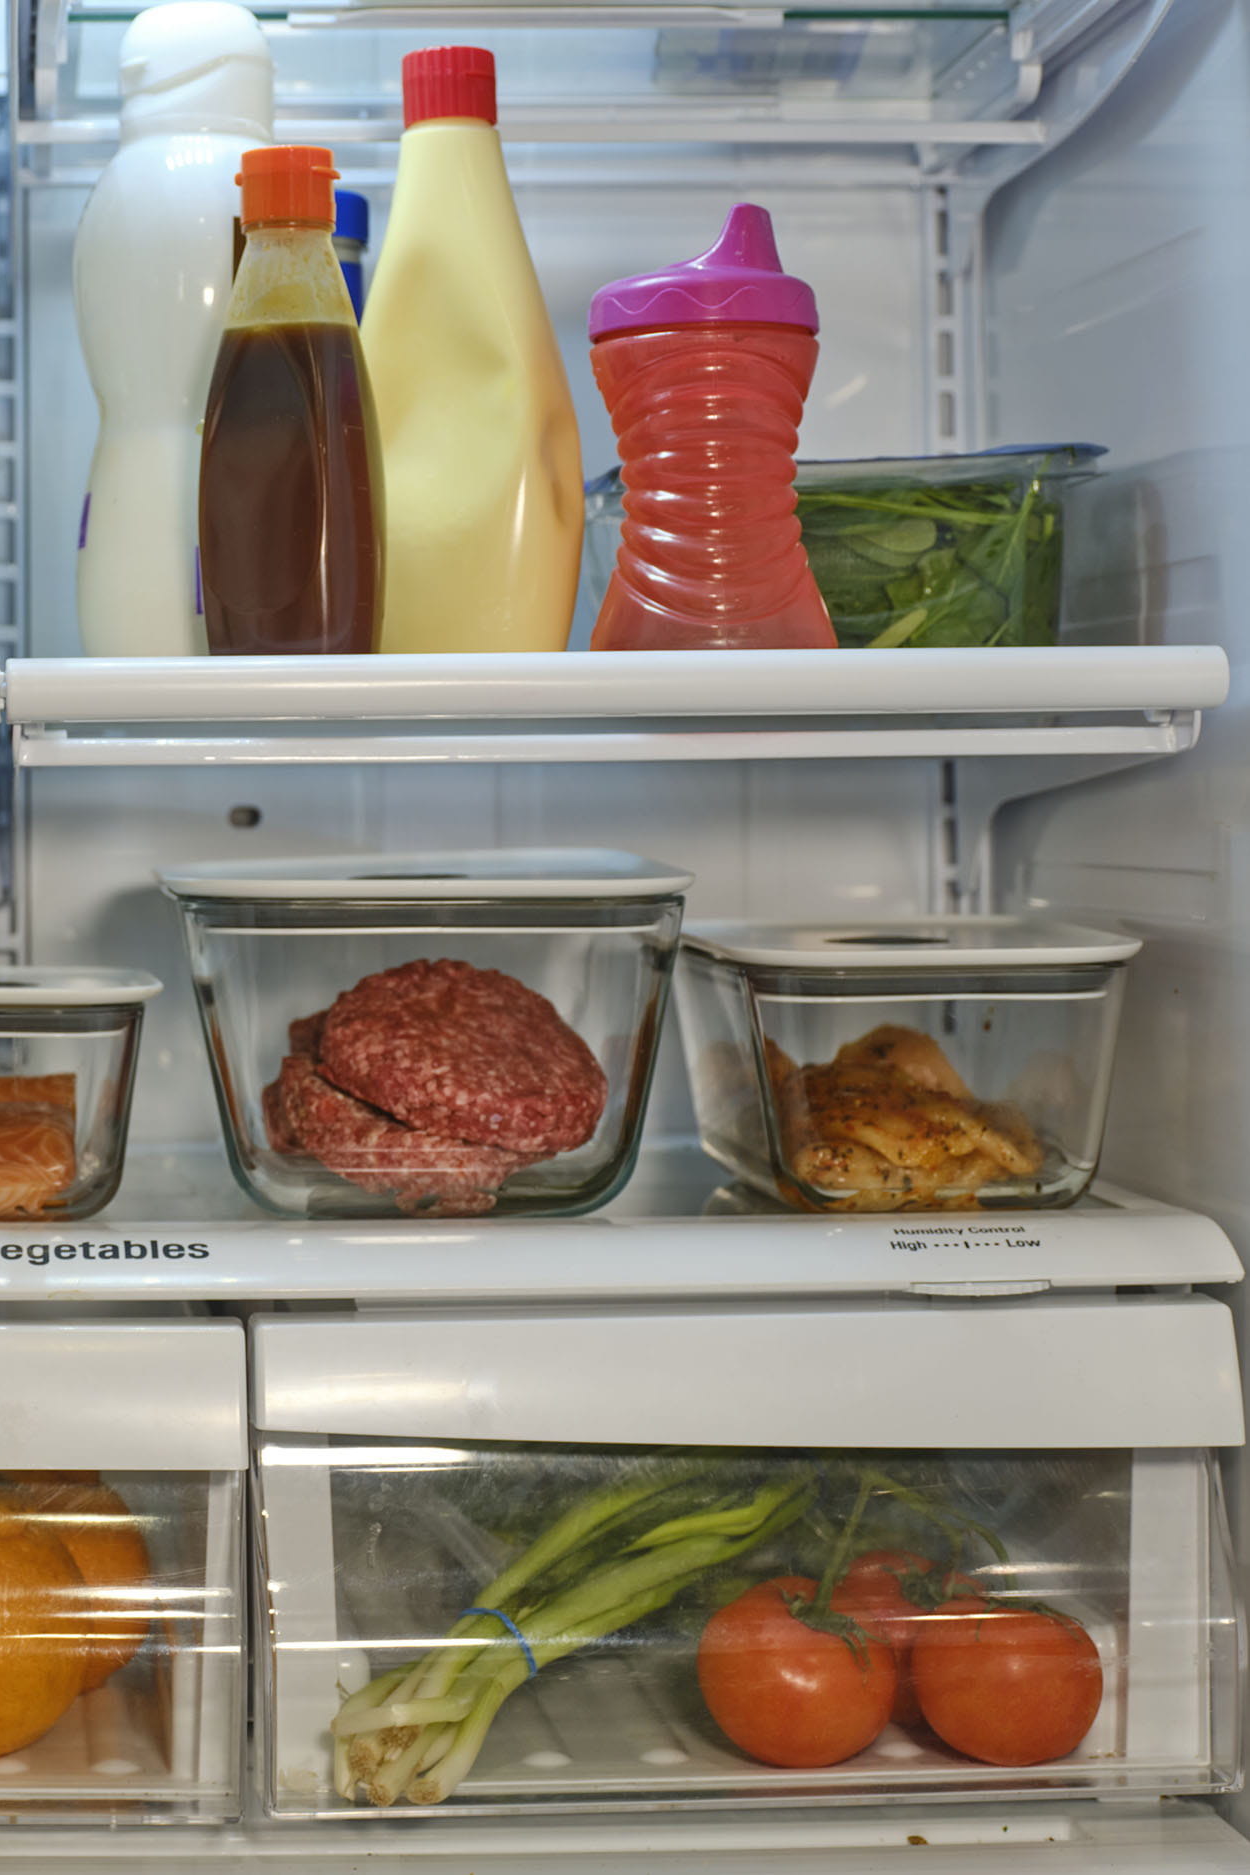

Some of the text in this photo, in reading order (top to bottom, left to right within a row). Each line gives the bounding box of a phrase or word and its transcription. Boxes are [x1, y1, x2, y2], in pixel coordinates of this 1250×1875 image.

[893, 1225, 1026, 1236] Humidity Control
[890, 1238, 1042, 1251] High Low
